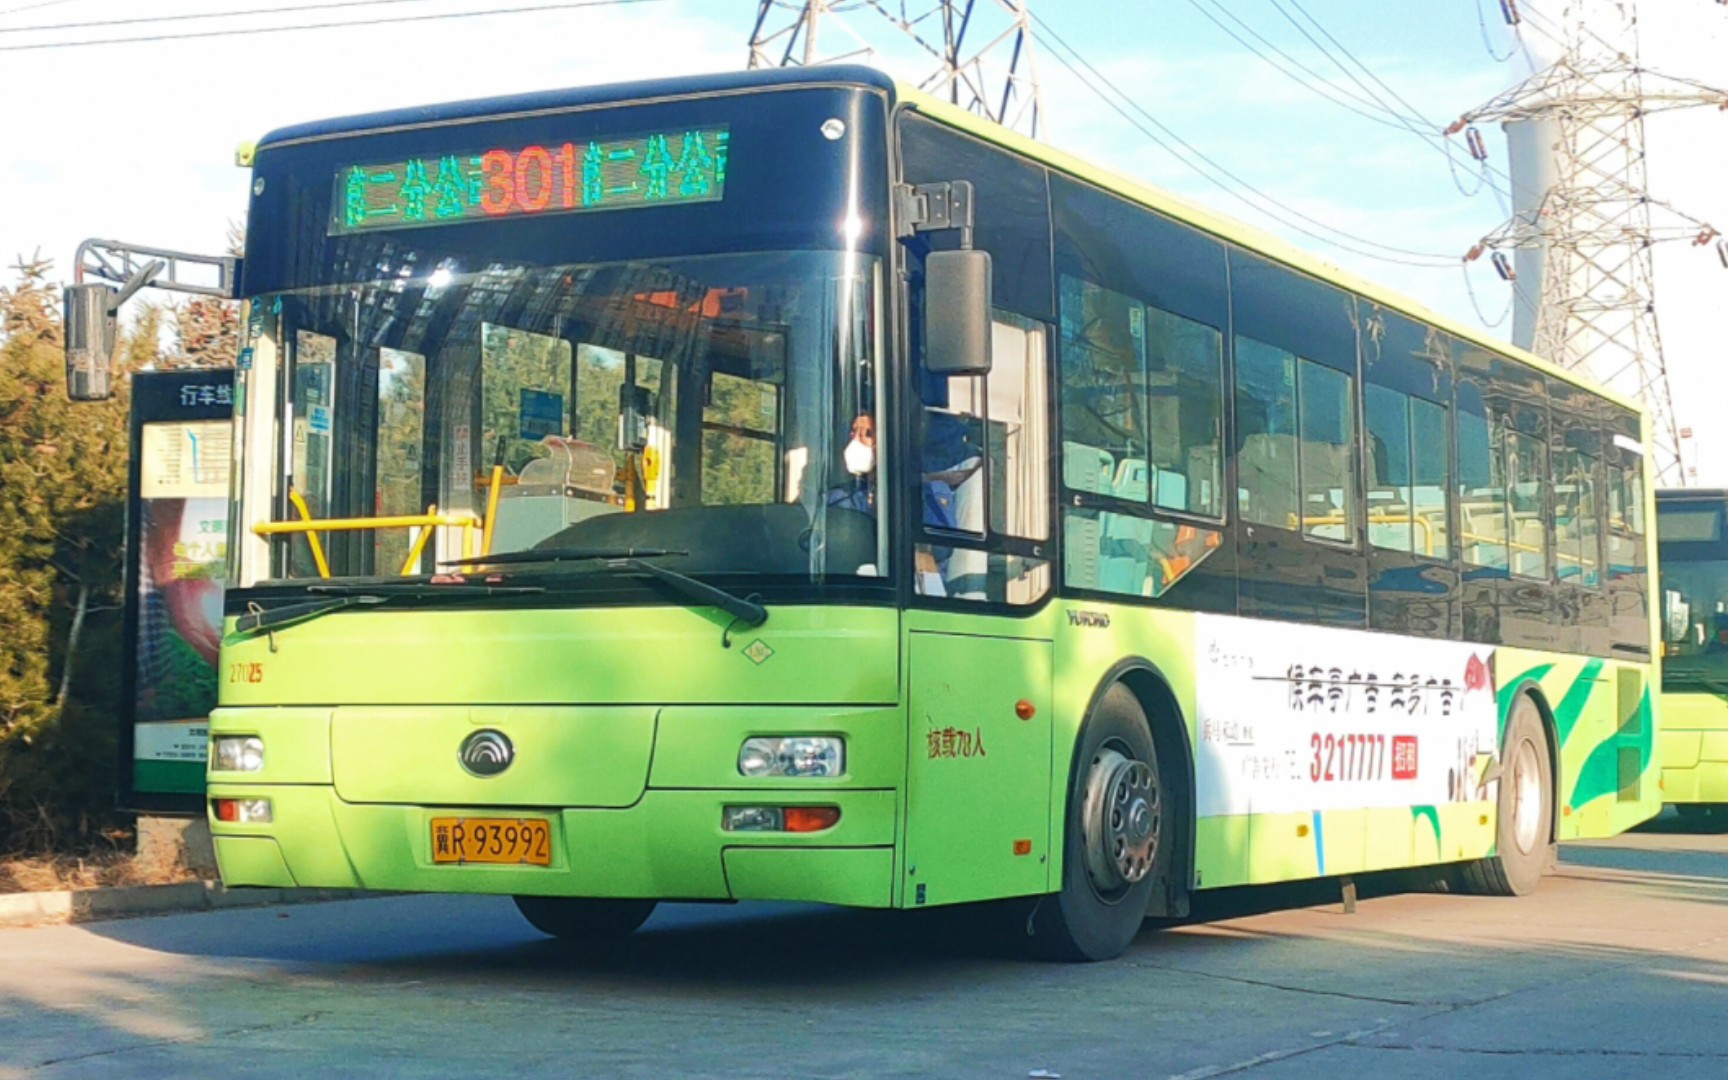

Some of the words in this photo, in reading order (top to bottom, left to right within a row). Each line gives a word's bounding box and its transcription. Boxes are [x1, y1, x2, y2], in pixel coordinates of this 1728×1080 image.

[480, 142, 575, 216] 301
[926, 726, 986, 759] 核载78人
[1310, 732, 1385, 782] 3217777
